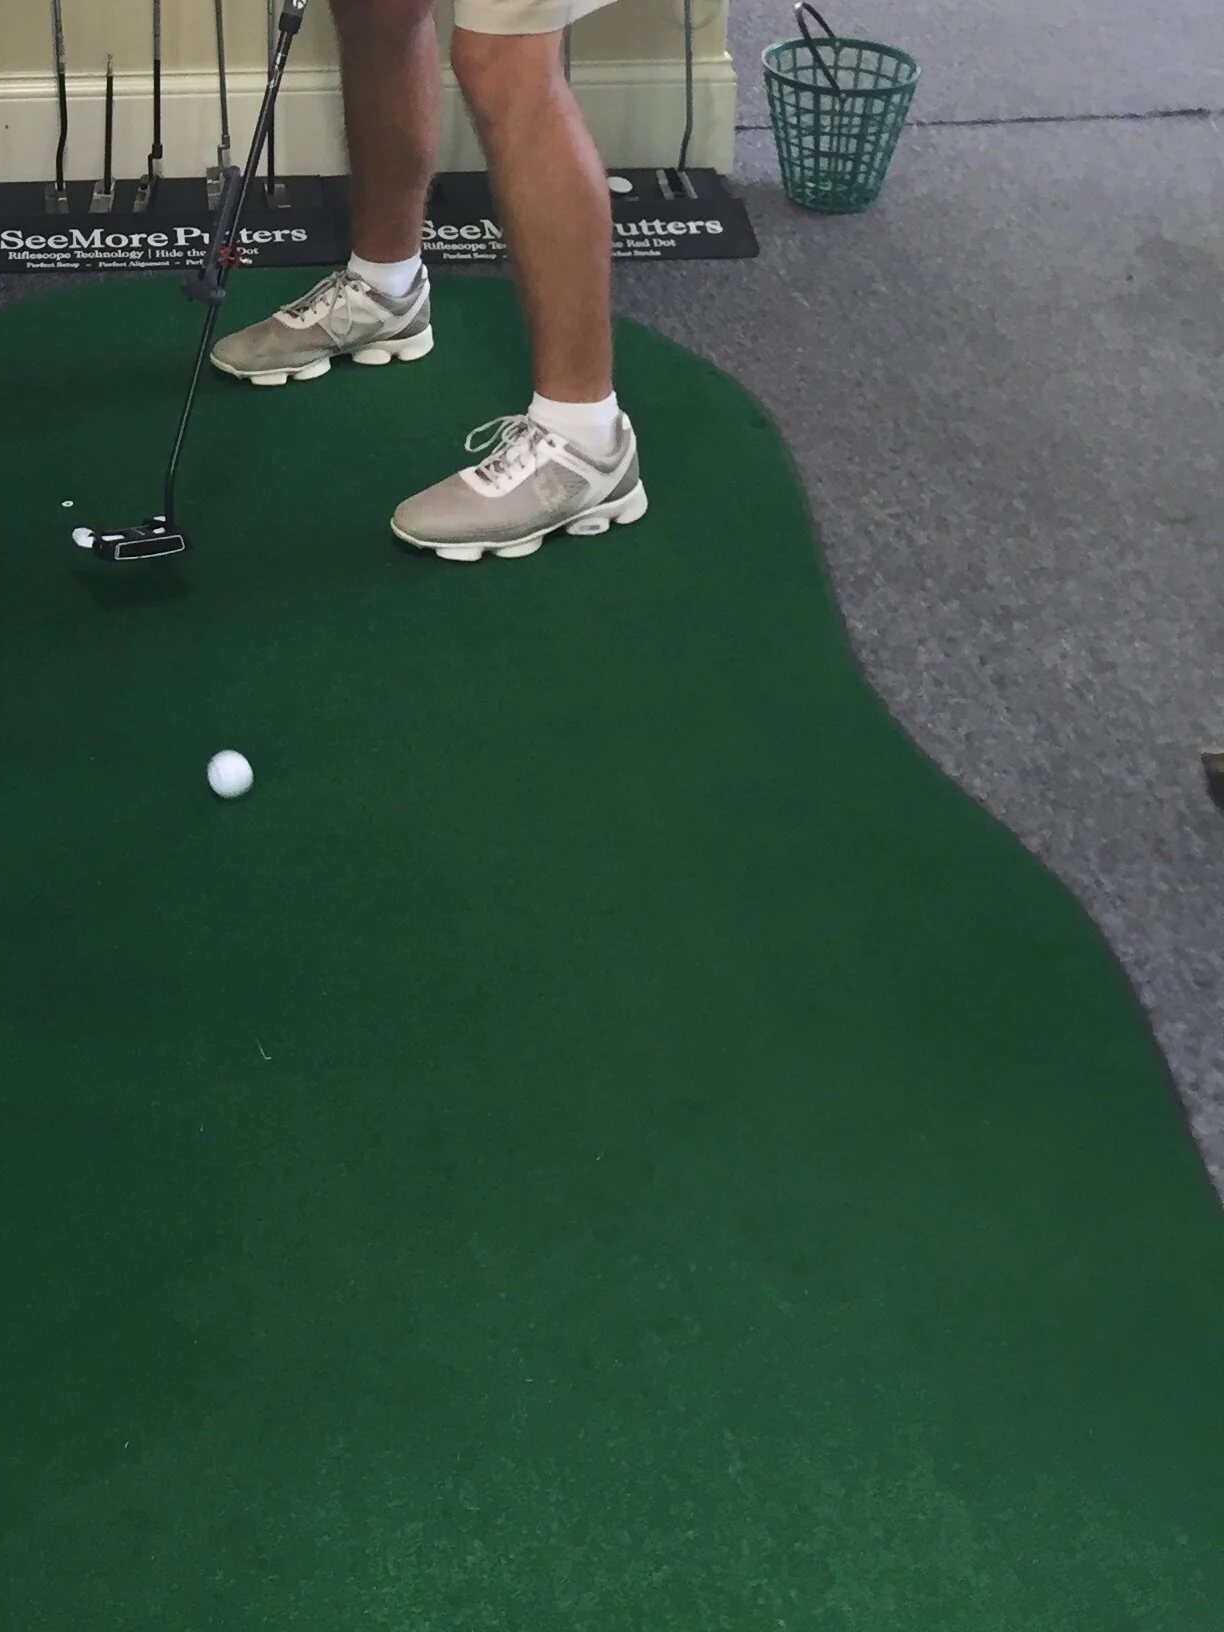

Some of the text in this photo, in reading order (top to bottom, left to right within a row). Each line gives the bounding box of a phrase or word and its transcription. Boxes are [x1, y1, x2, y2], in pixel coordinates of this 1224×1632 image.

[615, 219, 724, 236] utters
[0, 227, 308, 250] SeeMore Pters
[423, 241, 487, 251] Riflescope
[626, 238, 651, 248] Red
[653, 237, 676, 247] Dot
[8, 251, 71, 261] Riflescope
[74, 249, 144, 260] Technology
[156, 249, 184, 258] Hide
[187, 248, 207, 257] the
